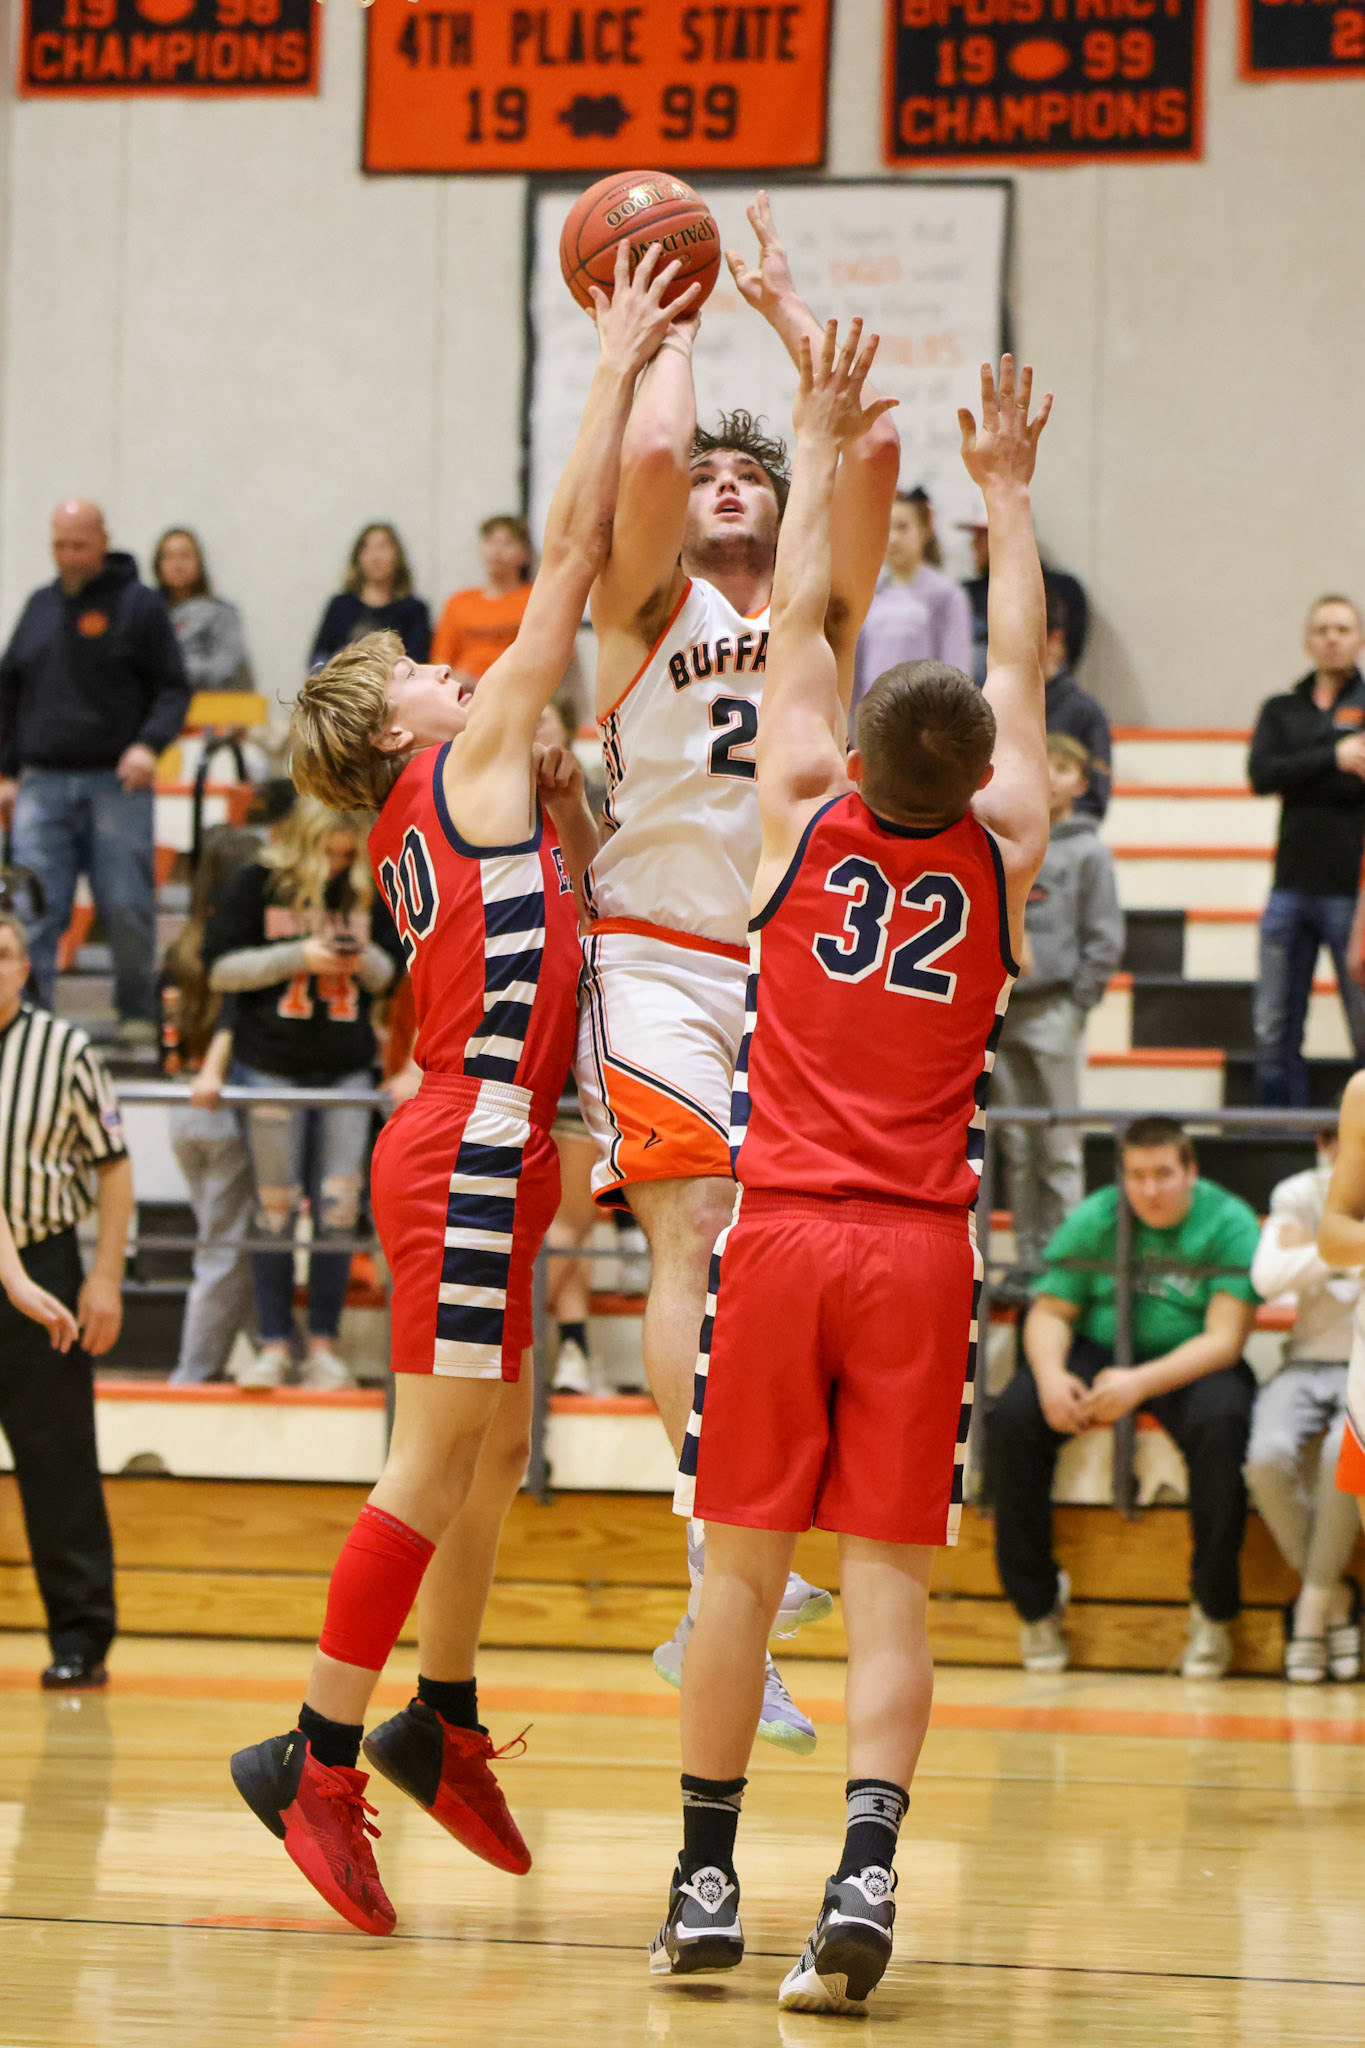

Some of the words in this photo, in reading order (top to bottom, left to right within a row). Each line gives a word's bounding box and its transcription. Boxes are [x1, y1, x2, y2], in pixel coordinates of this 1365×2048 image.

[32, 31, 308, 79] CHAMPIONS
[398, 12, 474, 67] 4TH
[510, 8, 643, 66] PLACE
[682, 5, 799, 63] STATE
[936, 35, 996, 86] 19
[1083, 30, 1155, 80] 99
[466, 86, 528, 142] 19
[660, 83, 739, 140] 99
[901, 88, 1187, 144] CHAMPIONS
[629, 215, 716, 270] SPALDNG
[707, 694, 758, 782] 2
[811, 853, 971, 1004] 32
